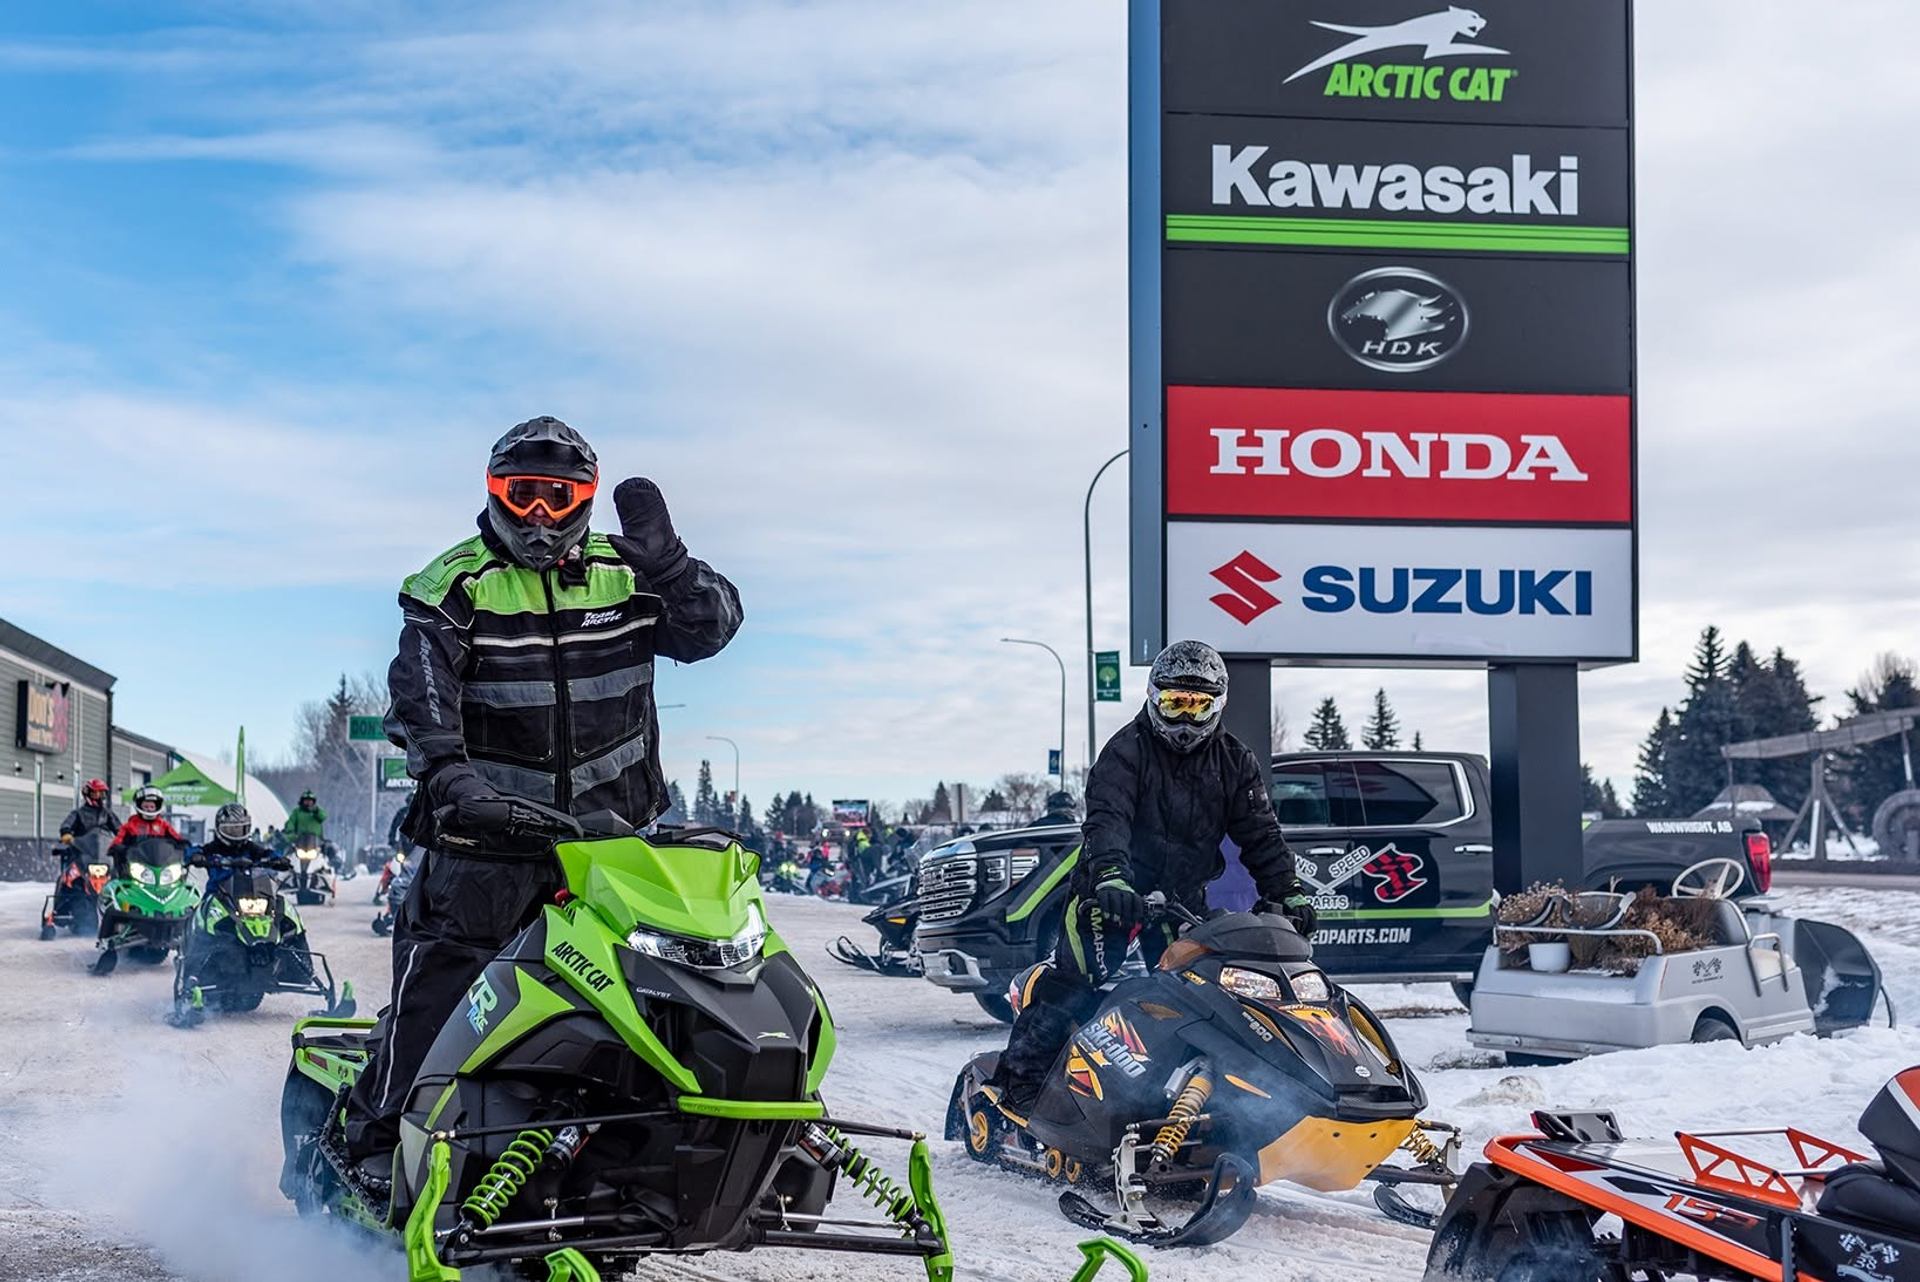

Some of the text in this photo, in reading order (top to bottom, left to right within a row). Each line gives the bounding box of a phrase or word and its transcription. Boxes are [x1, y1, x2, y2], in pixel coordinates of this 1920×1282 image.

[1323, 63, 1512, 101] ARCTIC CAT
[1212, 144, 1578, 215] Kawasaki
[1361, 340, 1442, 356] HDK
[1210, 428, 1588, 481] HONDA
[1302, 565, 1592, 616] SUZUKI
[1329, 845, 1370, 878] SPEED
[1309, 928, 1412, 944] EDPARTS.COM
[551, 941, 615, 993] ARCTIC CAT
